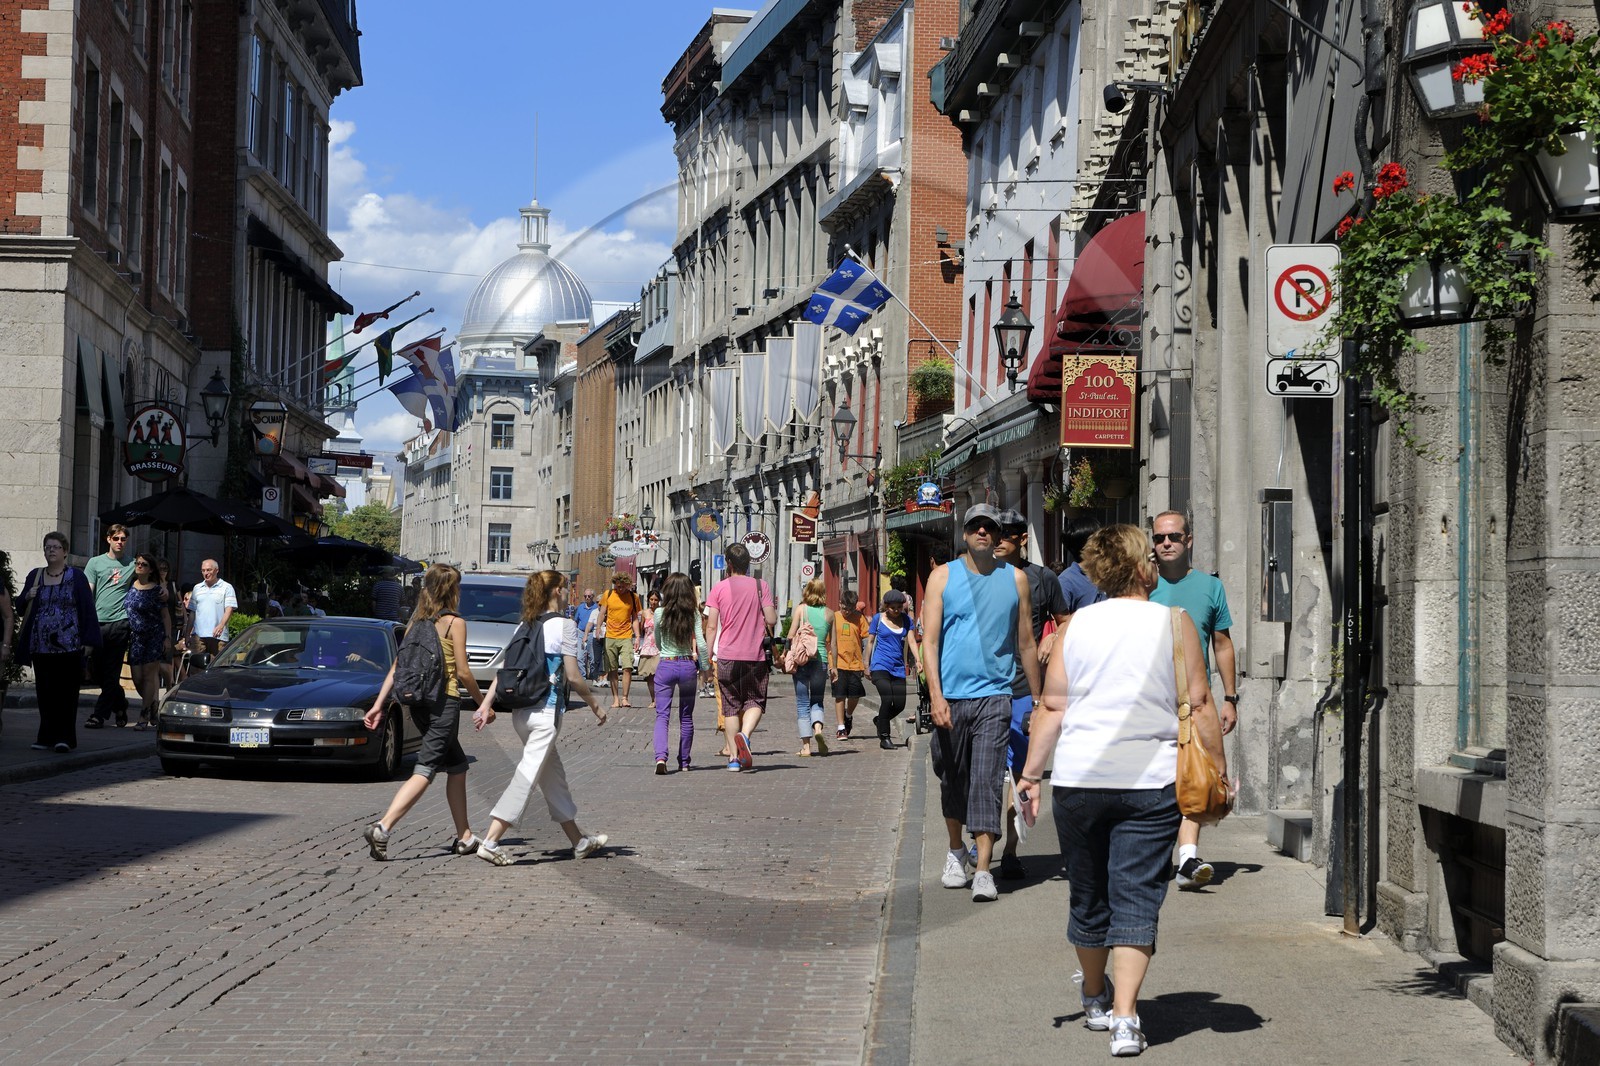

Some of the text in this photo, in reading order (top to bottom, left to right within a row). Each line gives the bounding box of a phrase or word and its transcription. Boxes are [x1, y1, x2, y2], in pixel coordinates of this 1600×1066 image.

[1084, 376, 1114, 388] 100
[1078, 391, 1106, 400] St-Paul
[1068, 408, 1129, 418] INDIPORT
[150, 451, 158, 460] 3
[130, 461, 178, 474] BRASSEURS
[1347, 608, 1355, 646] LOFT
[231, 732, 269, 742] AXFE 913
